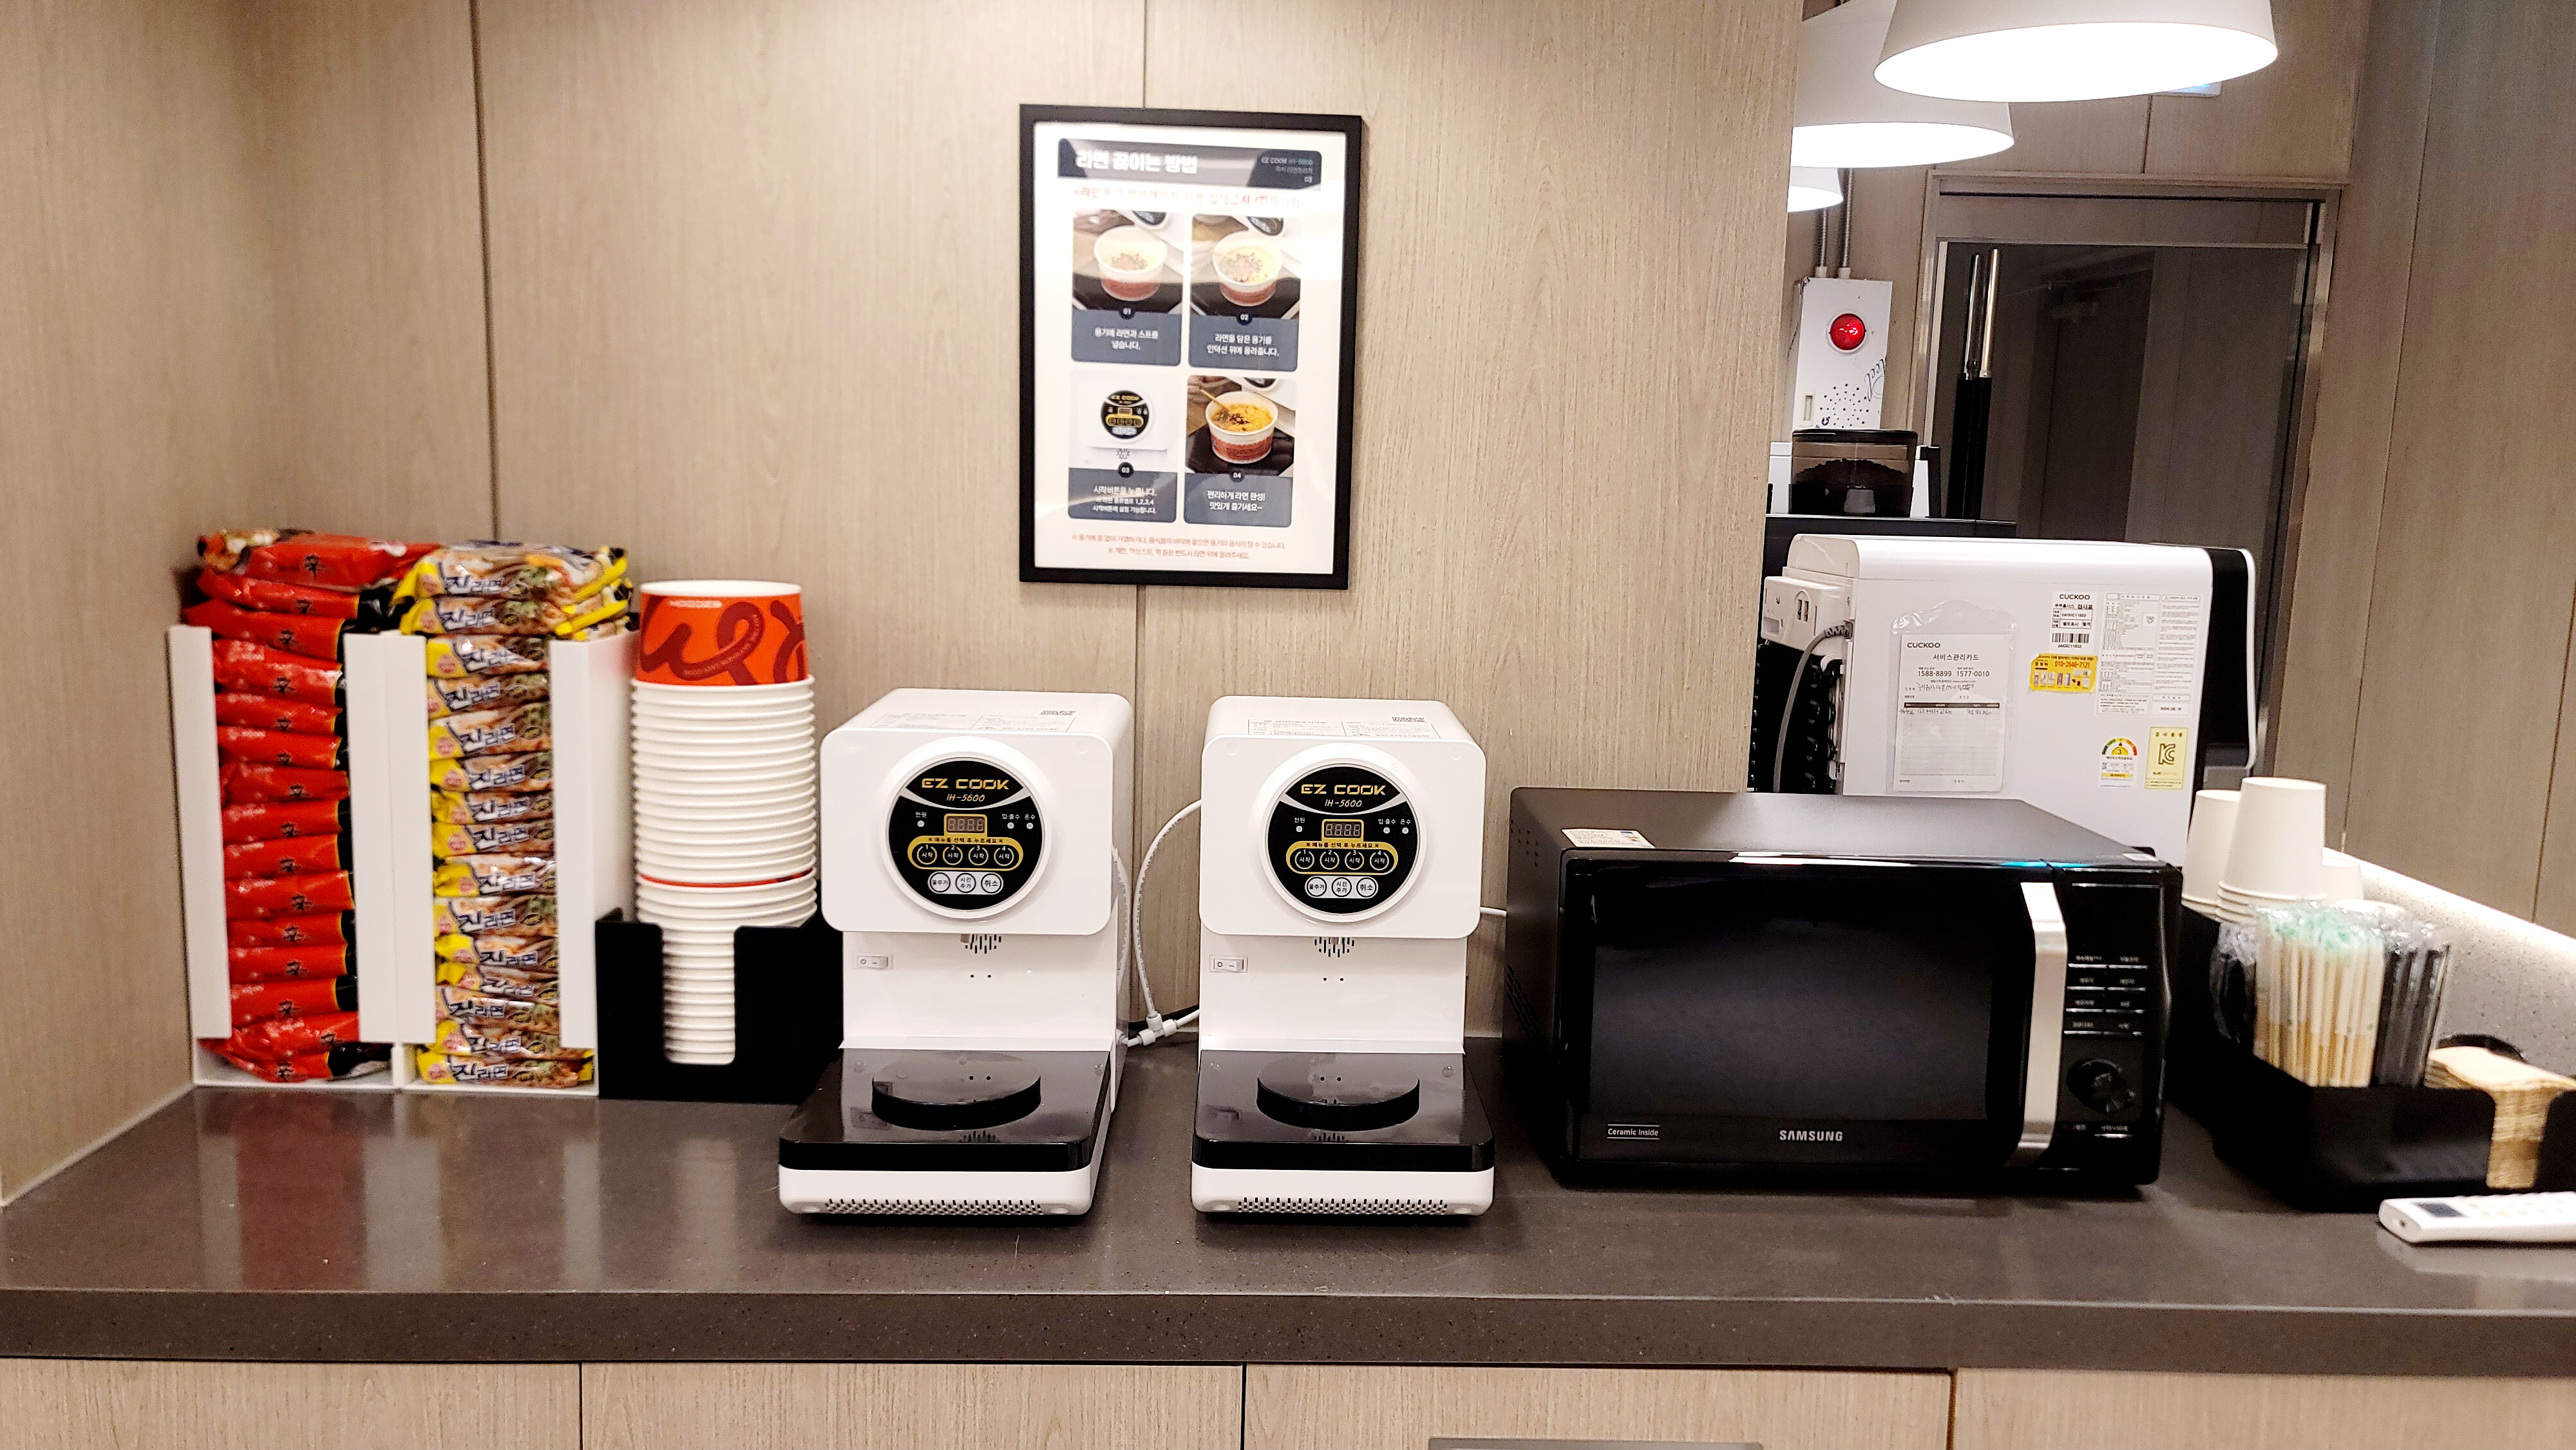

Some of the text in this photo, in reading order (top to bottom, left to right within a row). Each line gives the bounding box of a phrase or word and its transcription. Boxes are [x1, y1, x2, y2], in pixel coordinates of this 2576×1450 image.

[1076, 151, 1198, 174] 라면 끓이는 방법
[1095, 327, 1159, 339] 용기에 라면과 스프를
[1112, 340, 1141, 350] 넣습니다.
[1215, 334, 1272, 345] 라면을 담은 용기를
[1207, 344, 1227, 354] 인덕션
[1229, 345, 1243, 355] 위에
[1094, 485, 1157, 496] 시작버튼을 누릅니다.
[1208, 491, 1265, 502] 편리하게 라면 완성!
[1209, 502, 1229, 511] 맛있게
[445, 682, 501, 711] 진라면
[460, 724, 515, 752] 진라면
[469, 764, 526, 790] 진라면
[922, 778, 1009, 790] EZ COOK
[1301, 784, 1387, 795] EZ COOK
[946, 794, 985, 802] IH-5600
[1324, 799, 1363, 807] IH-5600
[471, 797, 529, 822] 진라면
[473, 825, 529, 850] 진라면
[458, 909, 516, 933] 진라면
[480, 950, 538, 966] 진라면
[449, 999, 506, 1024] 진라면
[453, 1064, 509, 1080] 진라면
[1607, 1127, 1659, 1136] Ceramic Inside
[1779, 1129, 1844, 1142] SAMSUNG
